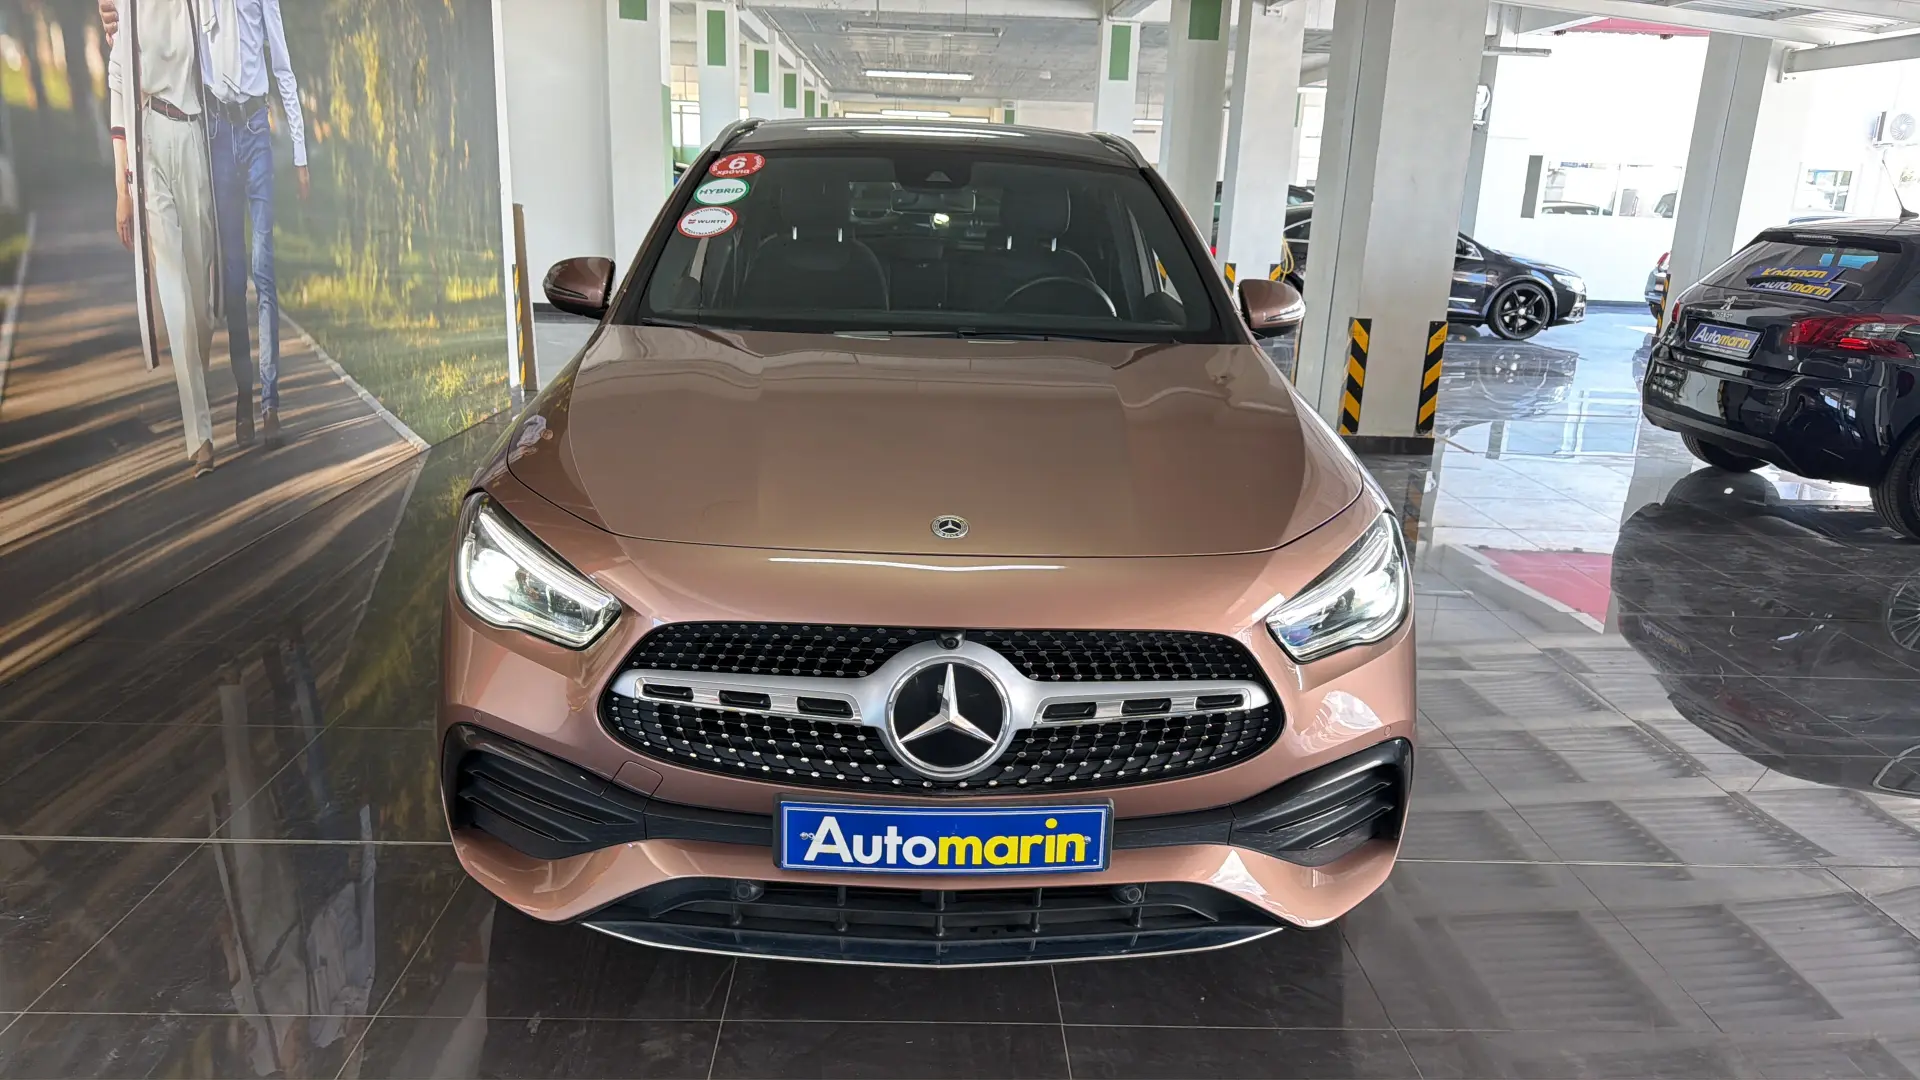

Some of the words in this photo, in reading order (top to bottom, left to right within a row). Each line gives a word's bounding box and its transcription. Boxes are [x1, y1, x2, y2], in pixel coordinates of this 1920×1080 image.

[728, 157, 748, 170] 6
[699, 187, 744, 195] HYBRID
[1694, 326, 1751, 349] Automarin
[803, 816, 1085, 866] Automarin
